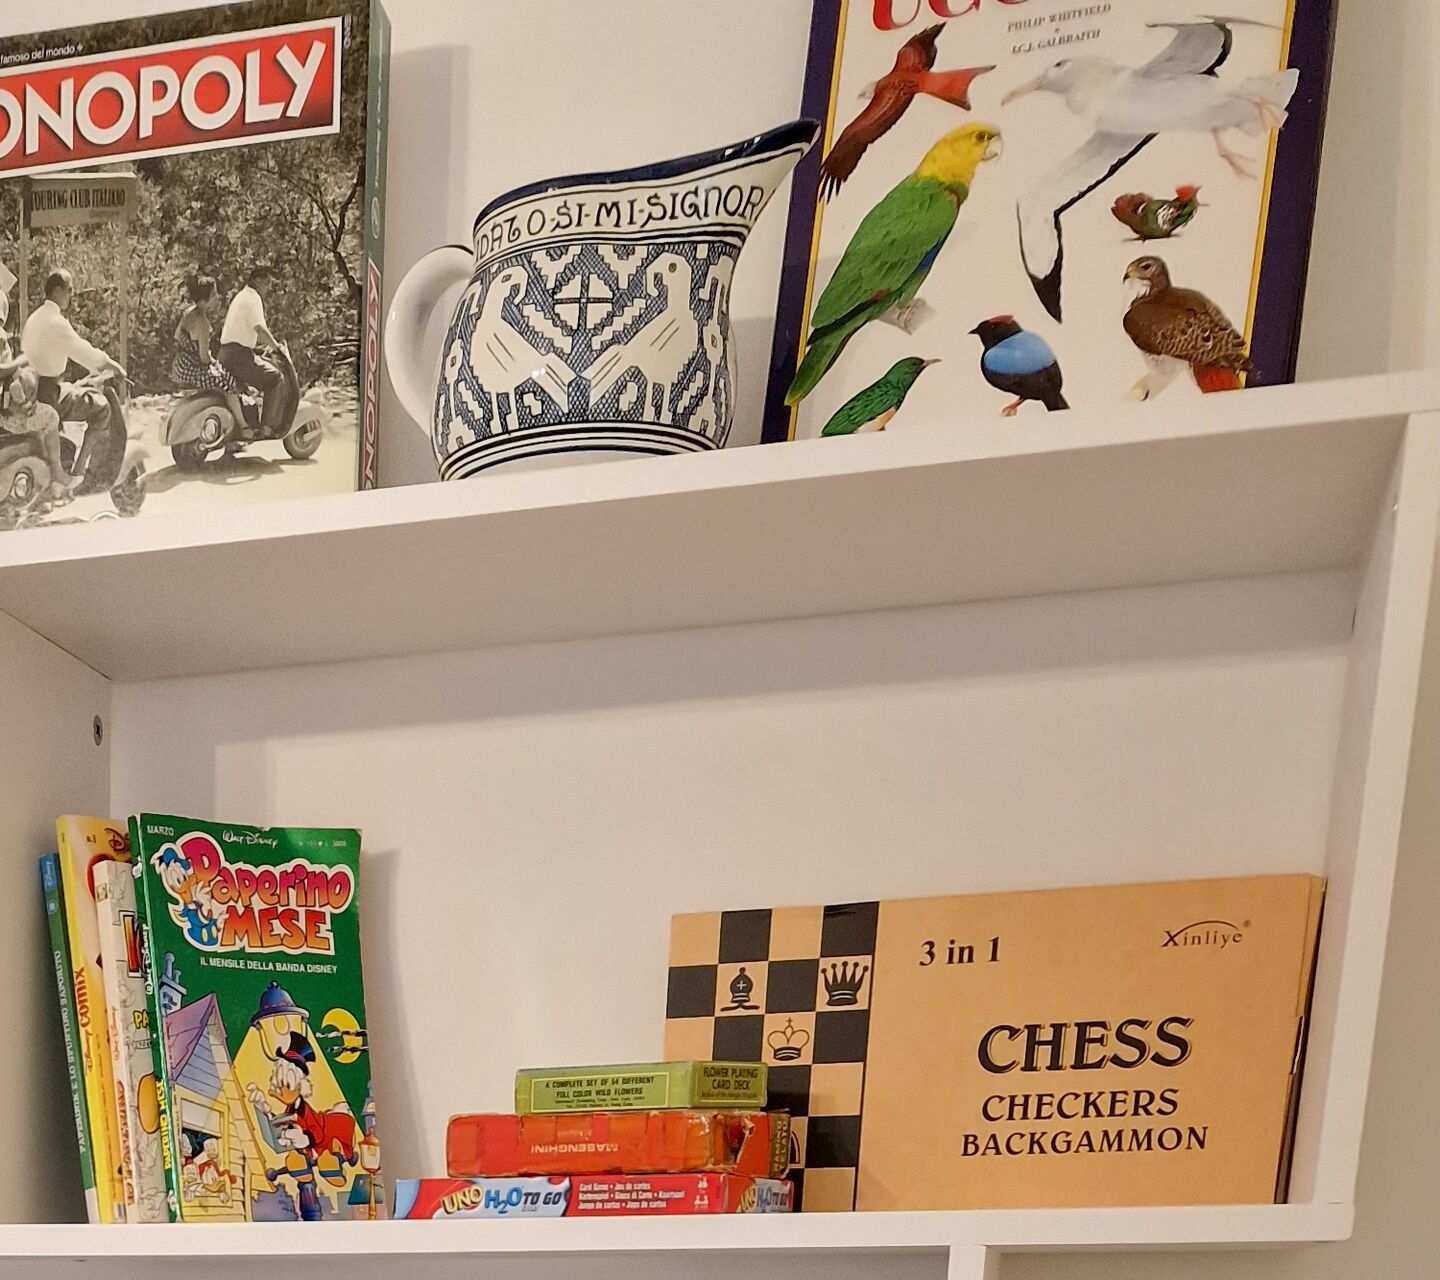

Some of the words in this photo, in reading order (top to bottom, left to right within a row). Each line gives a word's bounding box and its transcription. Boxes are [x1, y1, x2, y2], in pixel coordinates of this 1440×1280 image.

[1007, 16, 1047, 33] PHILIP
[1048, 2, 1112, 25] WHITFIELD
[1035, 28, 1101, 51] GALBRAITH
[0, 52, 30, 65] famoso
[31, 48, 46, 60] del
[46, 45, 76, 58] mondo
[30, 189, 69, 211] TOURING
[70, 189, 91, 209] CLUB
[91, 188, 126, 208] ITALIANO
[146, 824, 174, 837] MARZO
[181, 837, 352, 909] Paperino
[220, 906, 332, 950] MESE
[1161, 925, 1243, 949] Xinliye
[919, 940, 936, 966] 3
[946, 939, 975, 964] in
[987, 937, 1001, 962] 1
[200, 957, 208, 967] IL
[209, 958, 247, 969] MENSILE
[247, 960, 275, 970] DELLA
[276, 961, 305, 972] BANDA
[306, 963, 337, 974] DISNEY
[978, 1016, 1195, 1074] CHESS
[552, 1079, 583, 1088] COMPLETE
[586, 1078, 598, 1086] SET
[621, 1076, 655, 1085] DIFFERENT
[572, 1089, 593, 1098] COLOR
[595, 1088, 612, 1097] WILD
[613, 1087, 643, 1096] FLOWERS
[712, 1079, 733, 1090] CARD
[734, 1079, 751, 1091] DECK
[982, 1088, 1180, 1122] CHECKERS
[160, 1114, 170, 1170] PAPERINO
[961, 1126, 1209, 1157] BACKGAMMON
[579, 1183, 593, 1191] Card
[593, 1183, 609, 1191] Game
[442, 1184, 482, 1215] UNO
[523, 1191, 542, 1205] TO
[542, 1191, 563, 1206] GO
